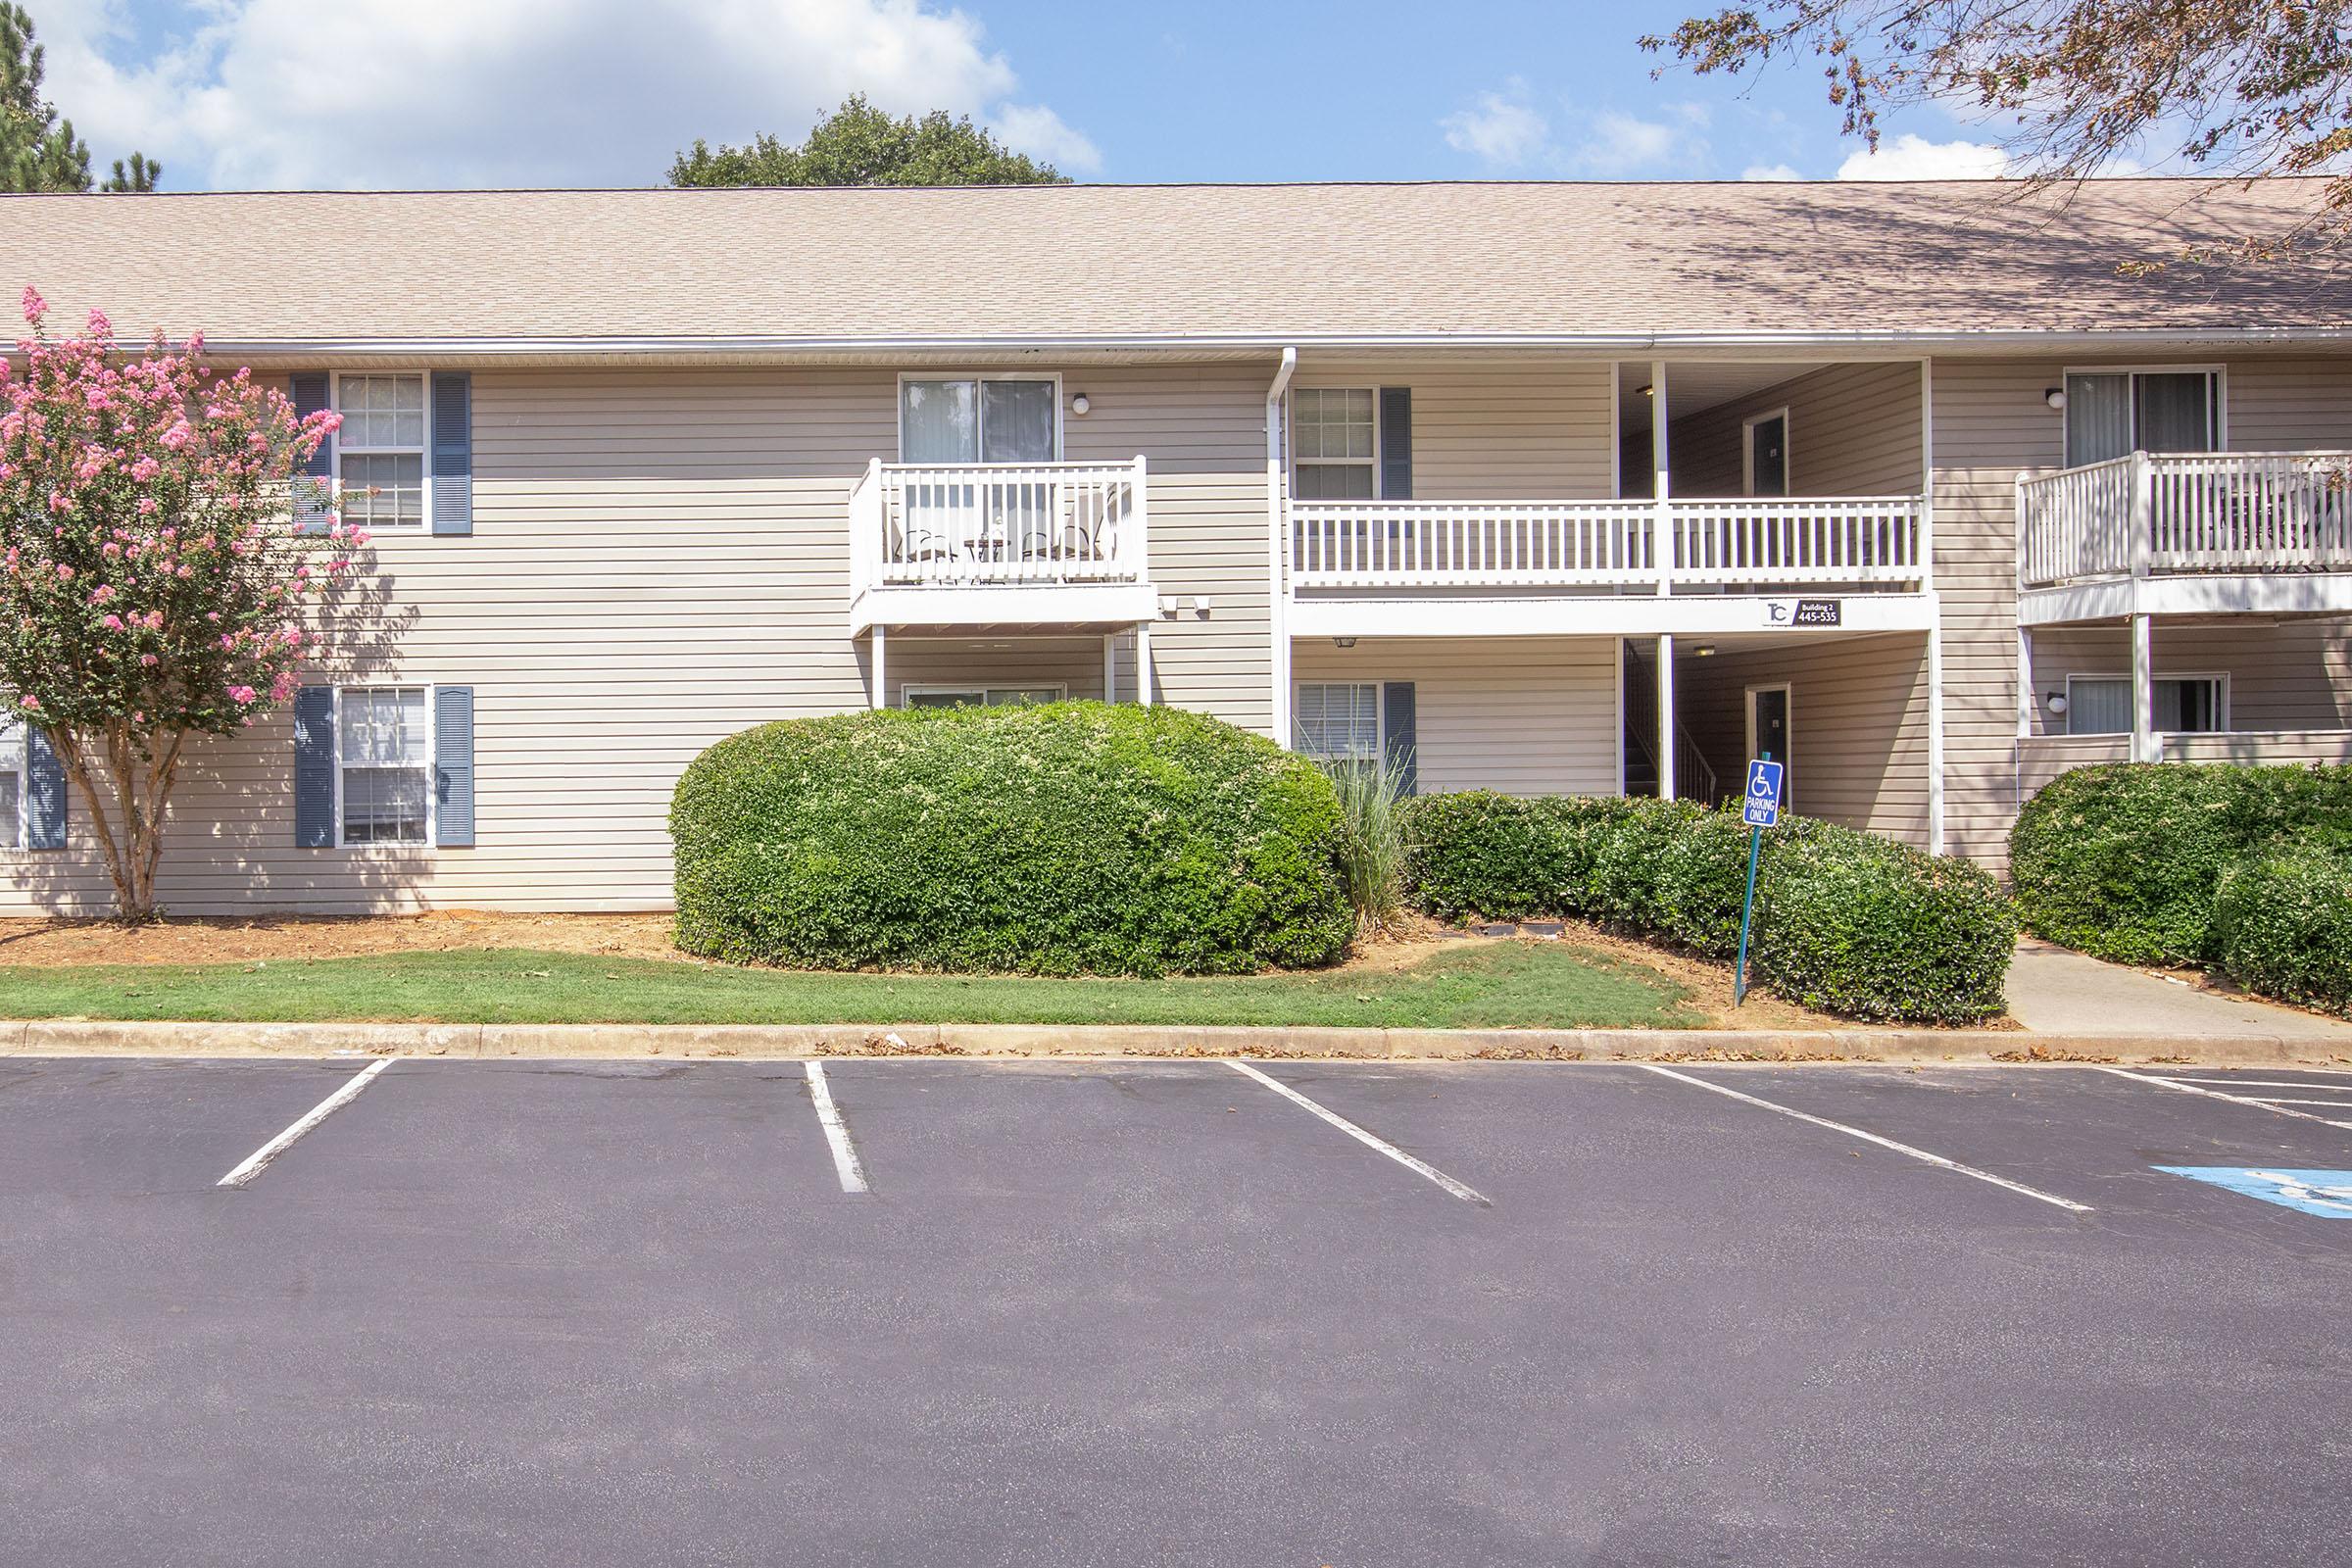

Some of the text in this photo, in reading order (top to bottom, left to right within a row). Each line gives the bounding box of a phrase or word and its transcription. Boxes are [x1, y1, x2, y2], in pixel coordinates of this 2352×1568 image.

[1798, 612, 1837, 621] 445-535
[1746, 797, 1775, 810] PARKING
[1749, 808, 1768, 821] ONLY
